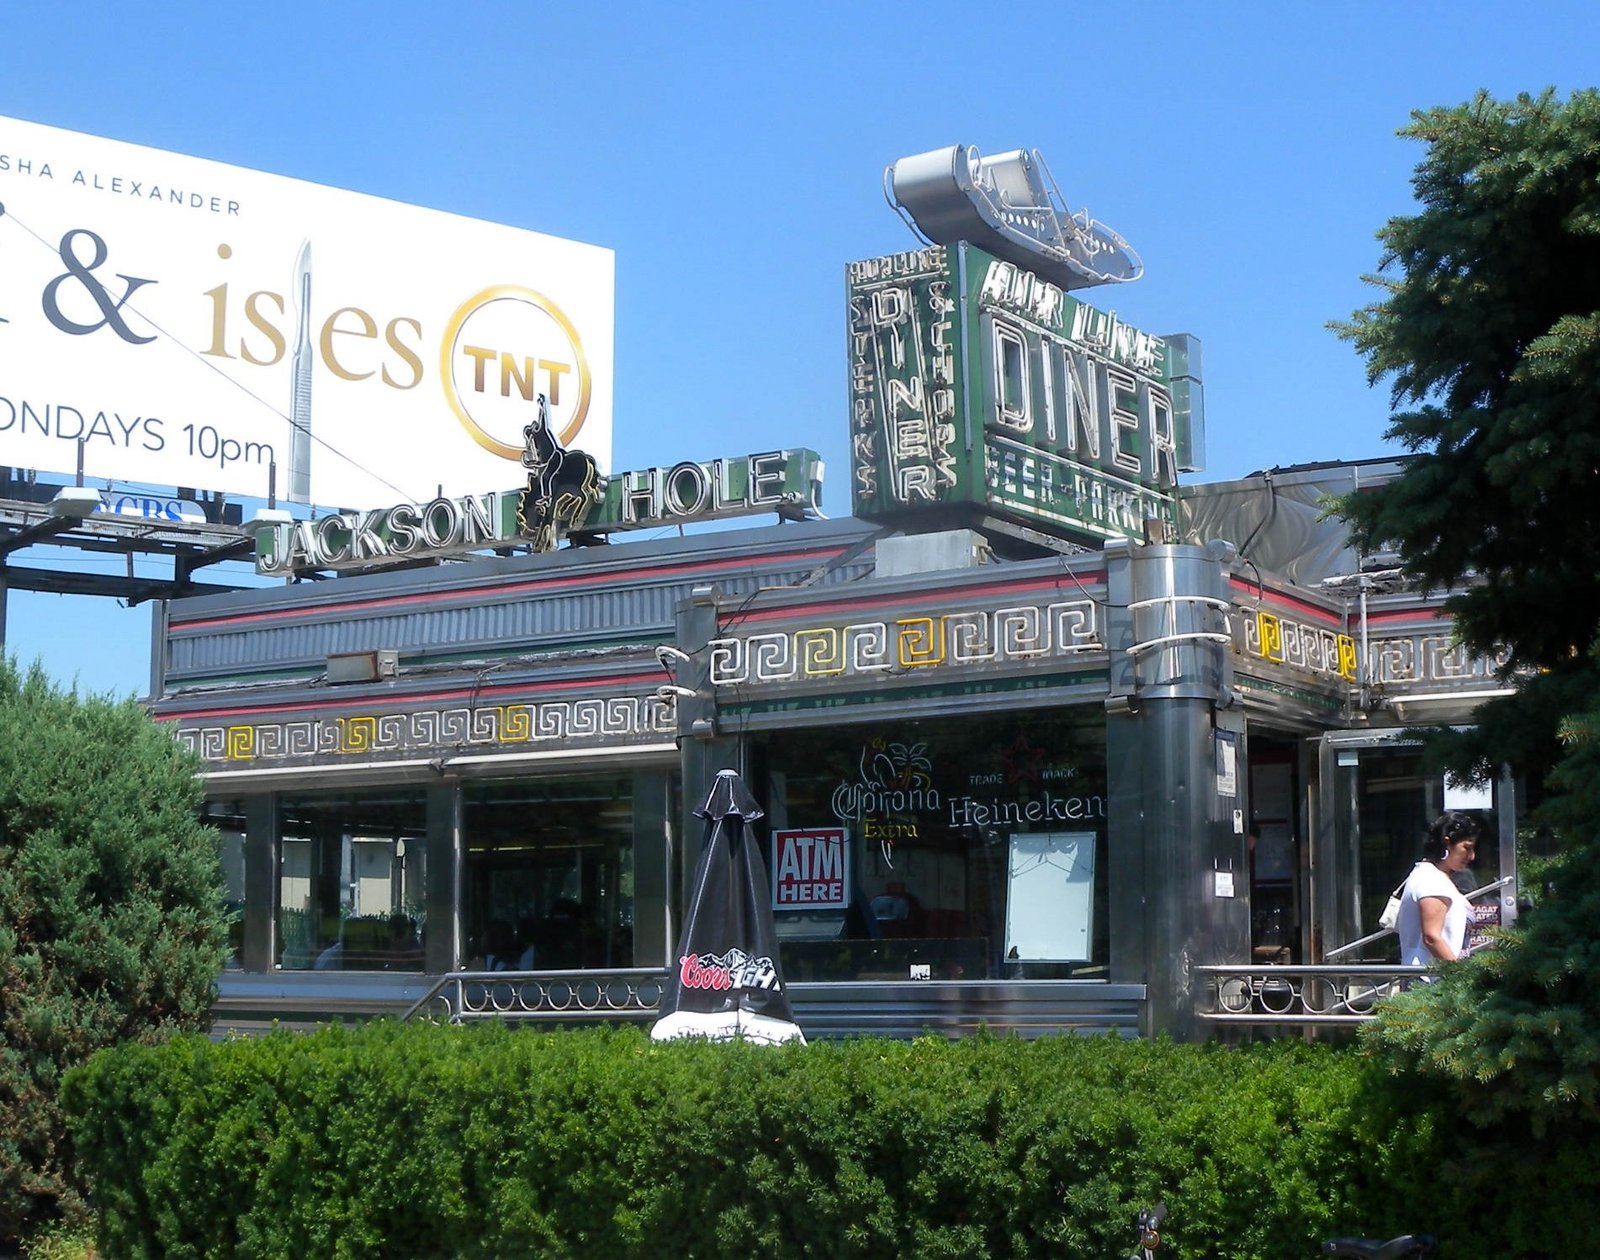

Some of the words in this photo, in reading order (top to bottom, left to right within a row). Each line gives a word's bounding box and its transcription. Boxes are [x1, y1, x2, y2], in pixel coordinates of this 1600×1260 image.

[73, 170, 240, 216] ALEXANDER
[42, 229, 158, 345] &
[463, 343, 572, 406] TNT
[872, 286, 937, 502] DINER
[990, 315, 1176, 487] DINER
[183, 423, 275, 469] 10pm
[259, 491, 502, 573] JACKSON
[622, 450, 788, 525] HOLE
[831, 780, 941, 821] Corona
[949, 791, 1106, 827] Heineken
[864, 819, 918, 838] Extra
[778, 834, 842, 881] ATM
[780, 883, 841, 902] HERE
[680, 953, 732, 991] Coors
